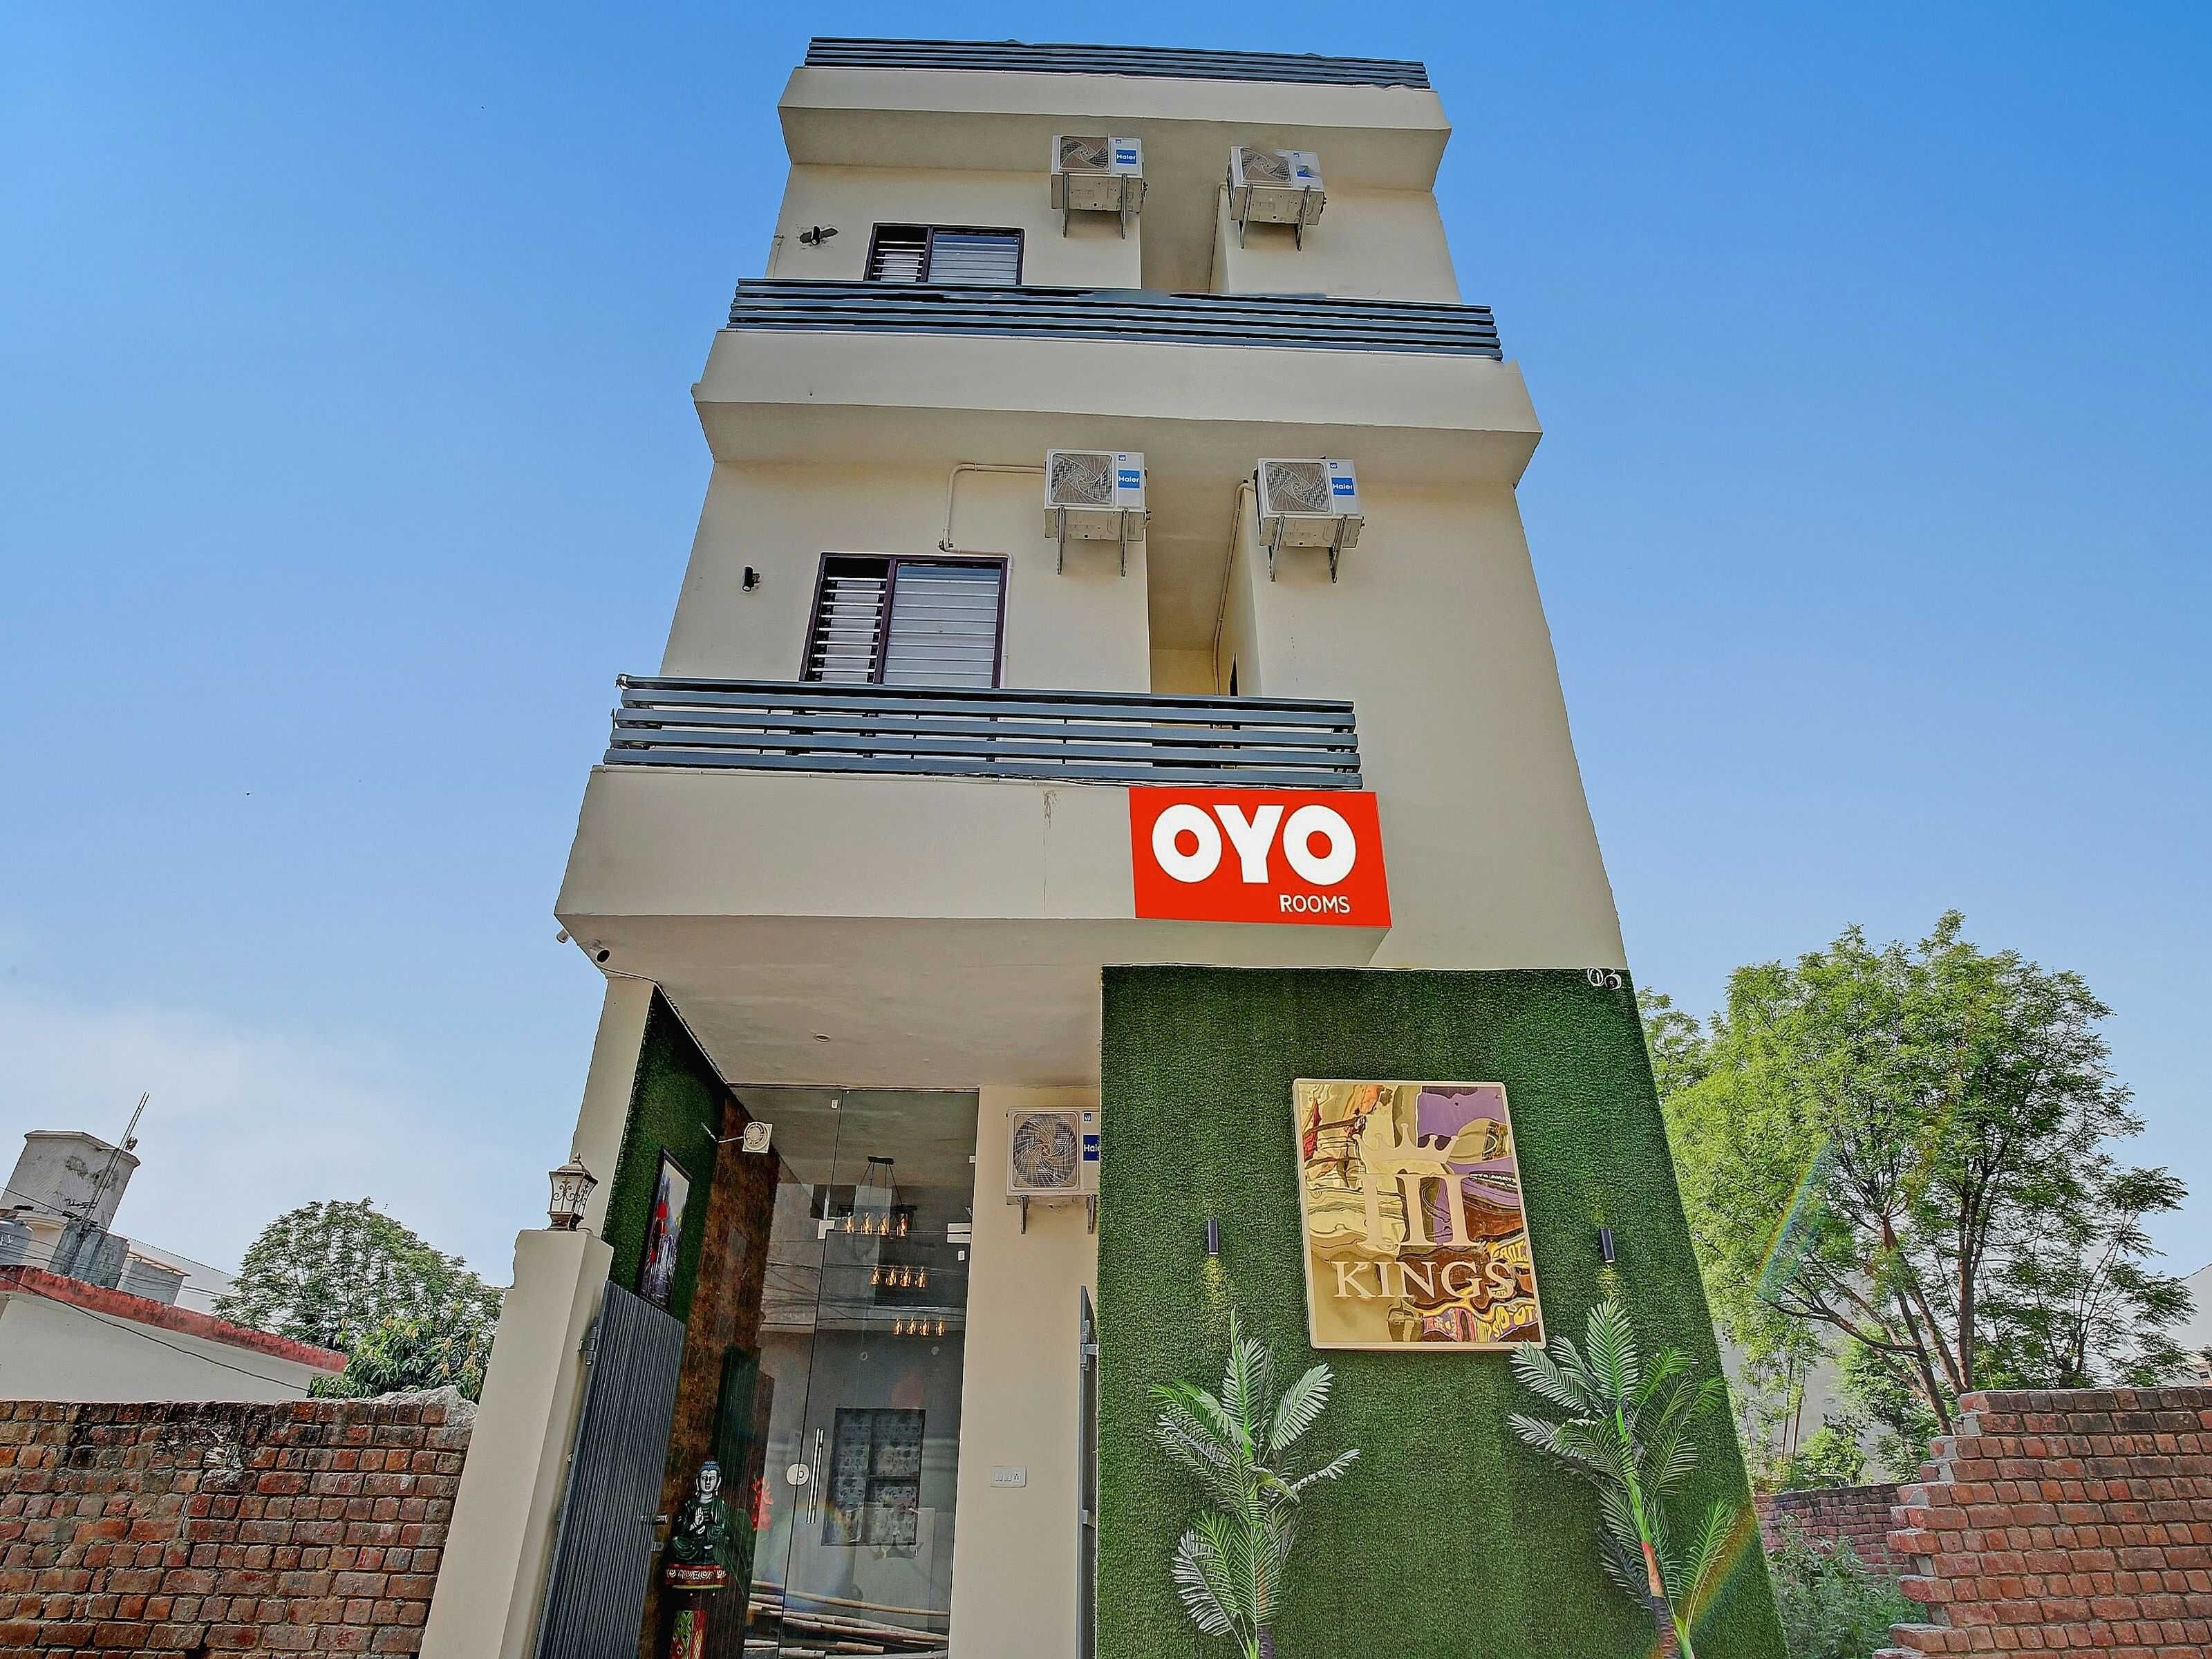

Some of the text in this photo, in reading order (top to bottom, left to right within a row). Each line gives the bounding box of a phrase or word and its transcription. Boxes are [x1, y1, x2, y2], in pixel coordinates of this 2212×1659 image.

[1152, 804, 1357, 885] OYO
[1280, 894, 1350, 914] ROOMS
[1331, 1261, 1516, 1299] KINGS
